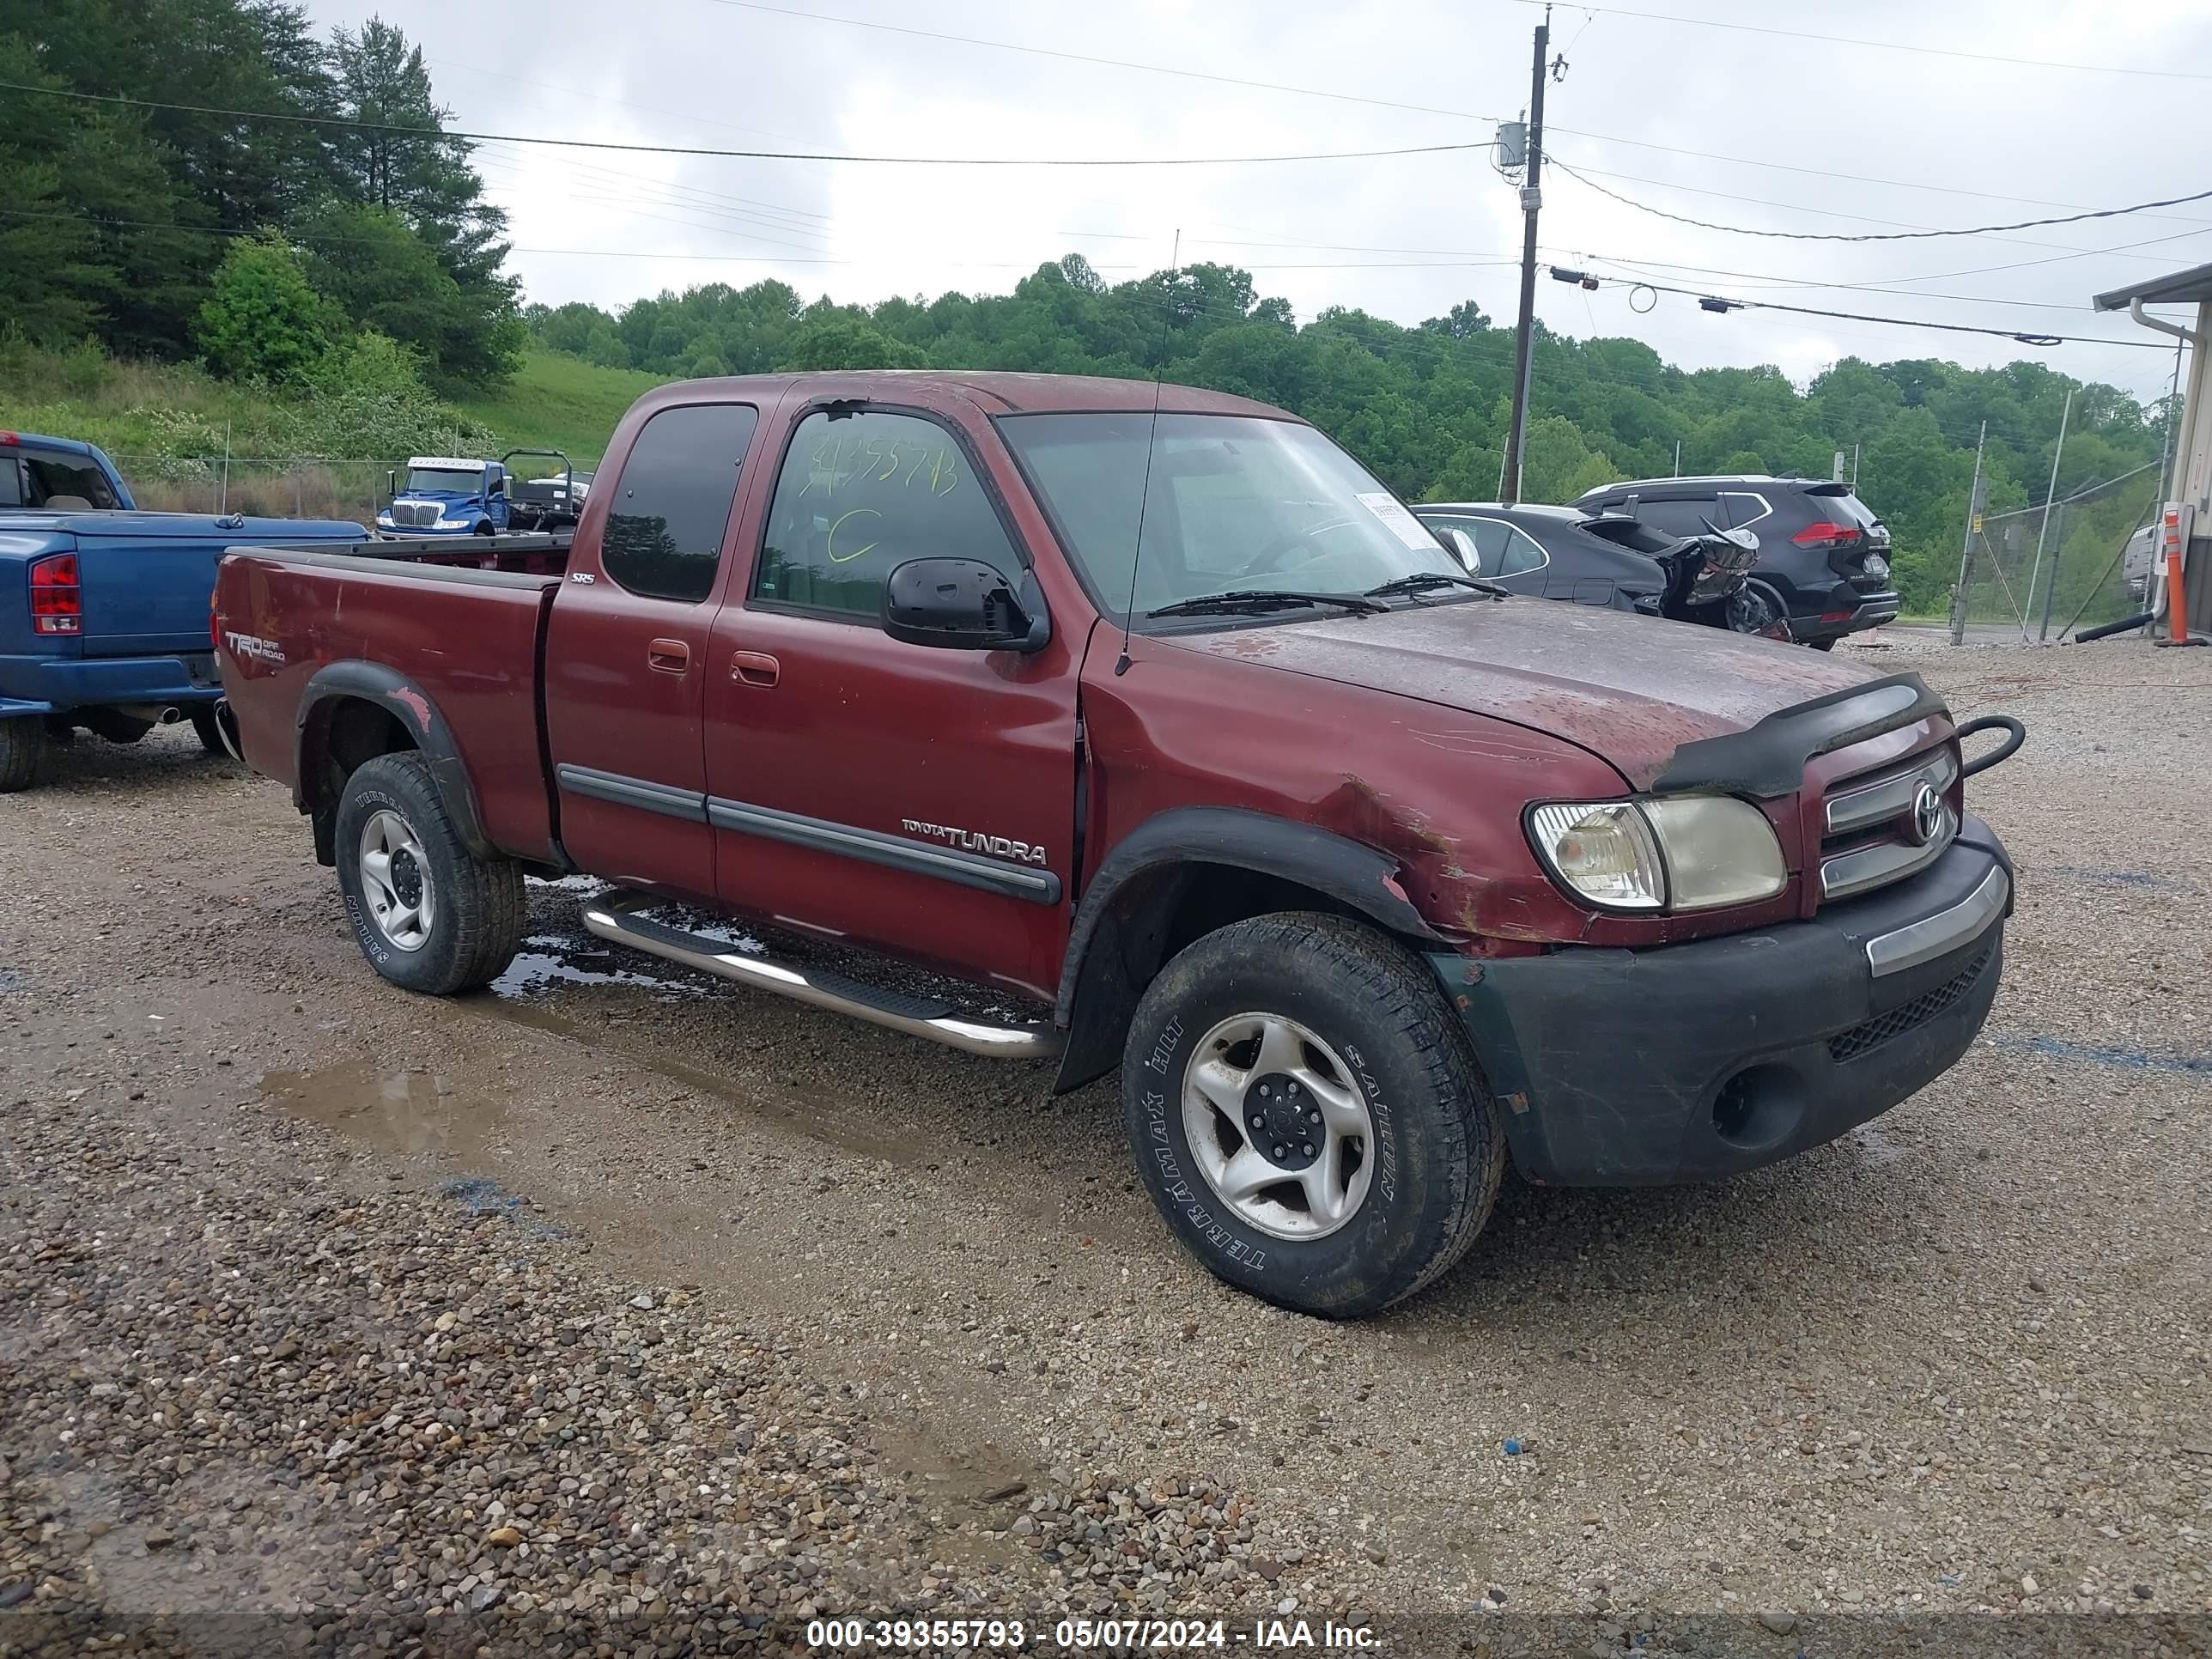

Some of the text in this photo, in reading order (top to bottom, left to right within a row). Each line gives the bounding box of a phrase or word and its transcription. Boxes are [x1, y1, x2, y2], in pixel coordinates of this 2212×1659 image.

[828, 508, 883, 563] C
[571, 572, 595, 585] SR5
[225, 631, 262, 658] TRD
[262, 649, 285, 660] ROAD
[263, 640, 279, 650] OFF
[902, 818, 1047, 866] TOYOTA TUNDRA
[346, 895, 389, 964] SAILUN
[1147, 1015, 1267, 1271] TERRAMAX HLT
[1345, 1044, 1397, 1202] SAILUN
